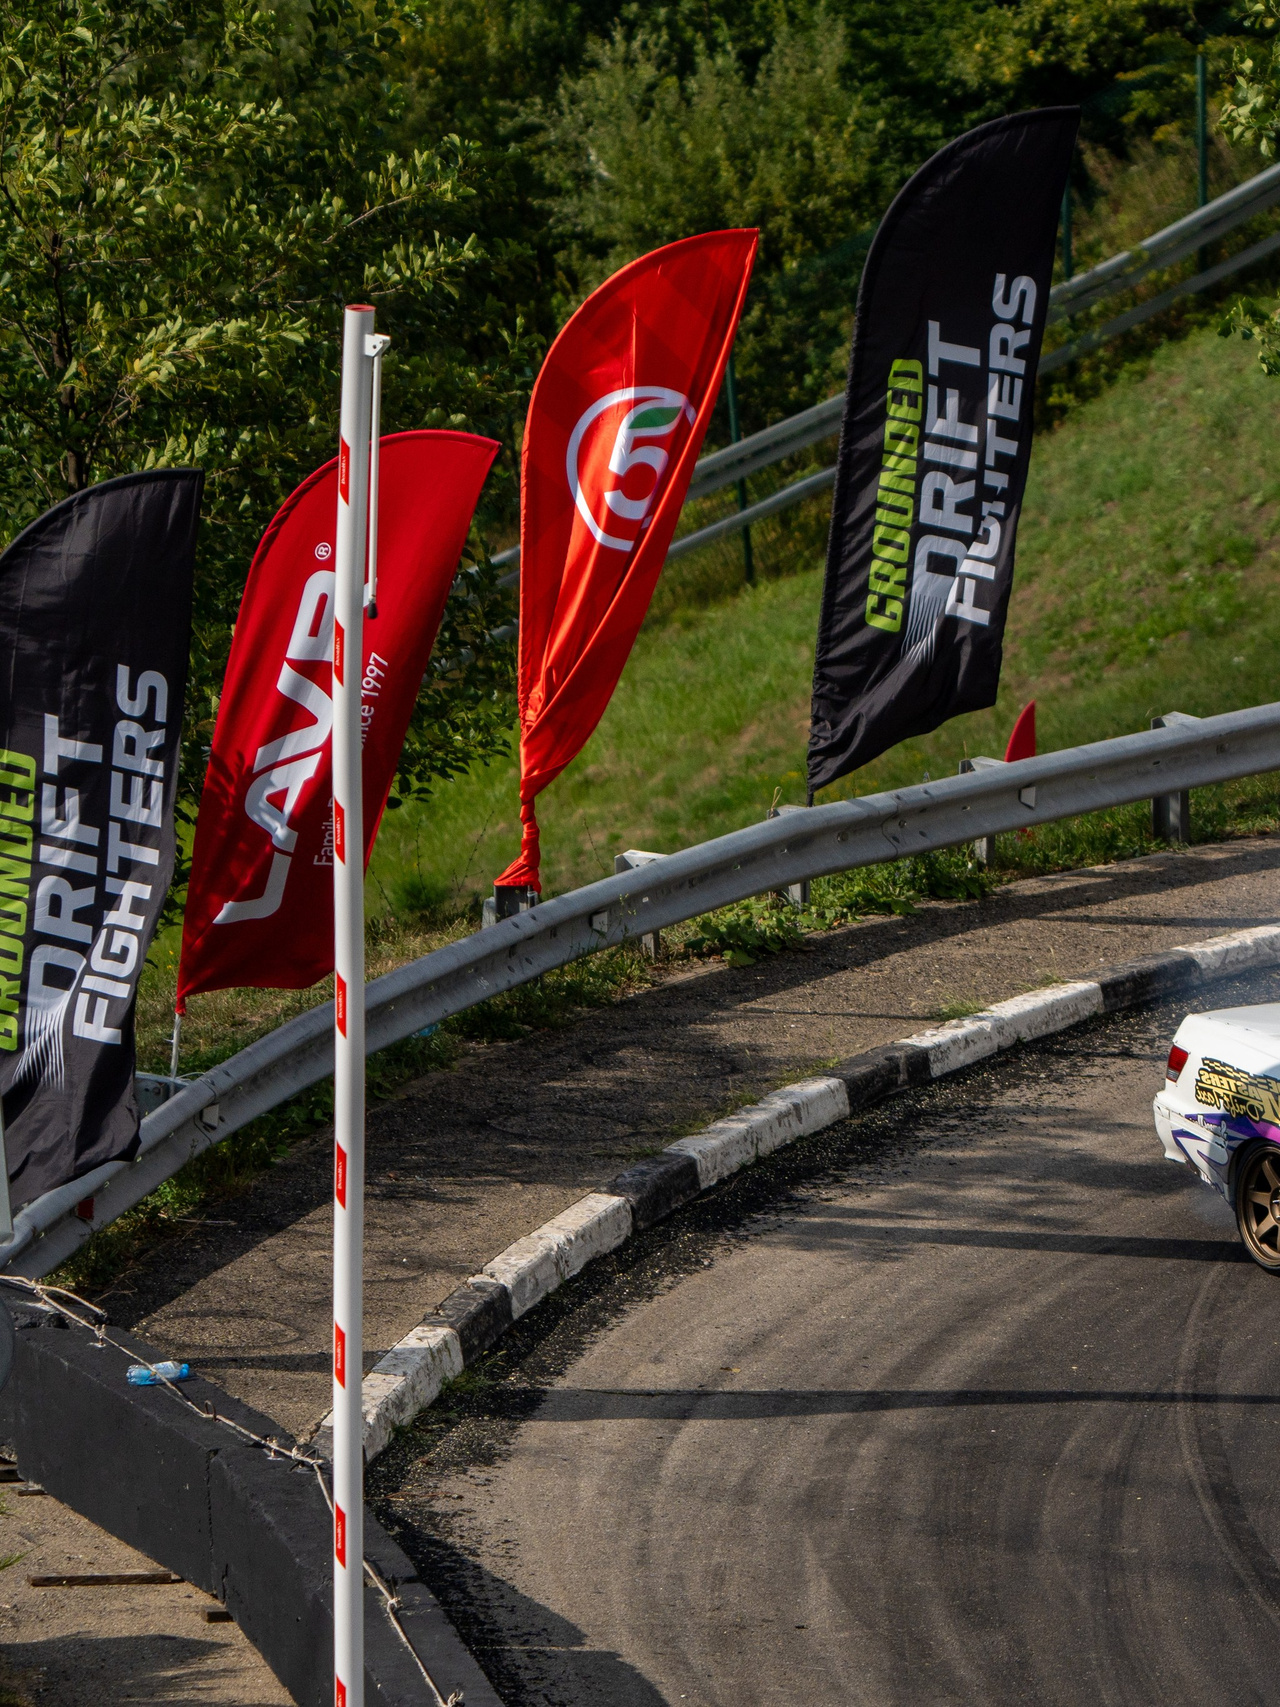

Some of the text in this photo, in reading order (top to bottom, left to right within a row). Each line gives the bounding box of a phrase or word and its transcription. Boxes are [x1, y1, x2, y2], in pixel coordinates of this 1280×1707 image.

[865, 358, 924, 633] GROUNDED
[905, 319, 981, 625] DRIFT
[945, 273, 1038, 626] FIGHTERS
[361, 652, 389, 698] 1997
[24, 713, 104, 1055] DRIFT
[73, 663, 169, 1045] FIGHTERS
